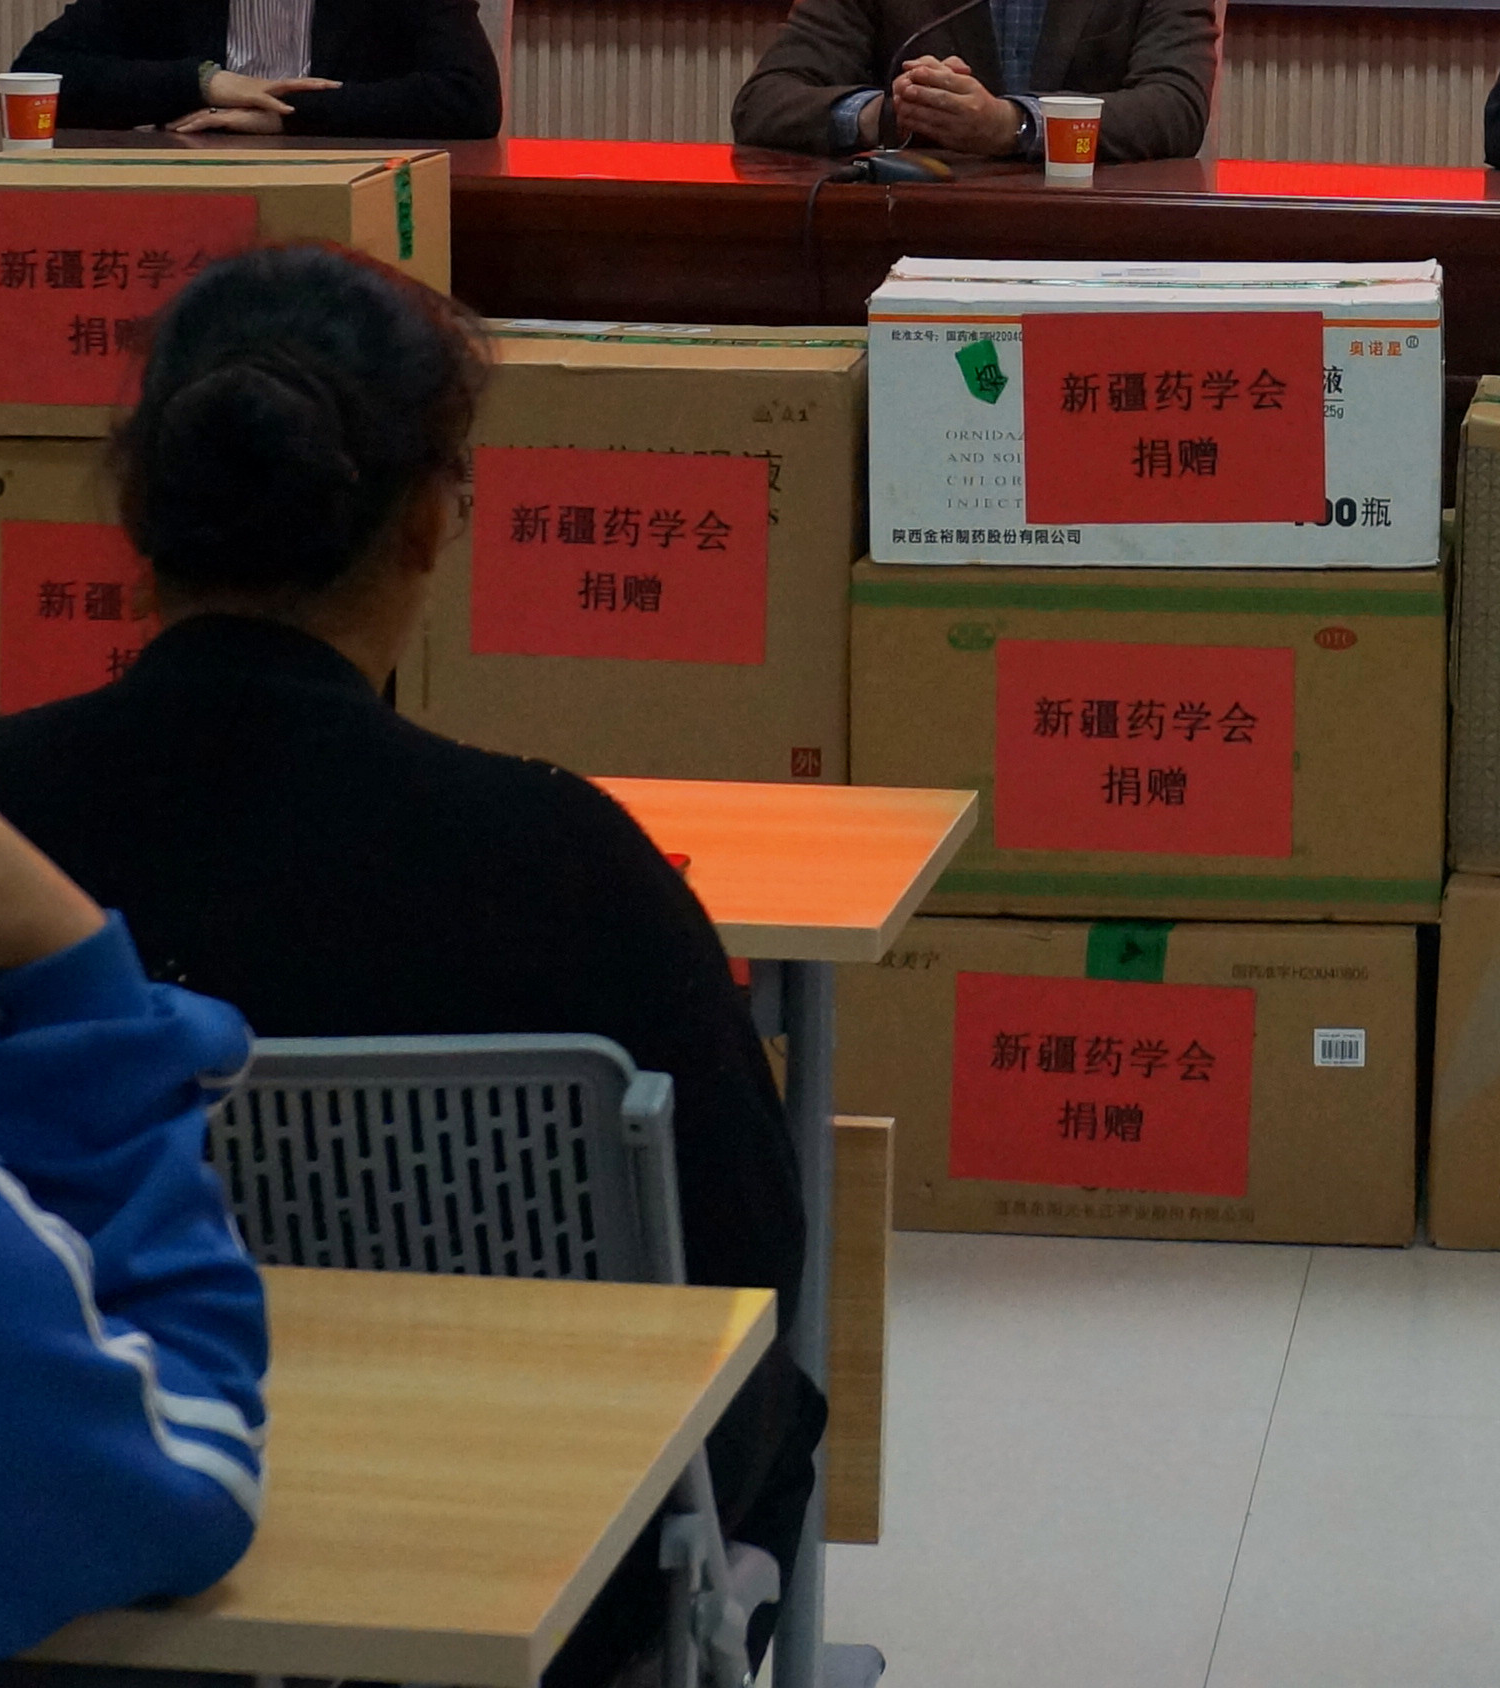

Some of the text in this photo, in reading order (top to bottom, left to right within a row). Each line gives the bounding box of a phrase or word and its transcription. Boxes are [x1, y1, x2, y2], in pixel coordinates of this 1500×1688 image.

[1350, 340, 1403, 357] 奥诺星
[1060, 367, 1288, 414] 新疆药学会
[948, 453, 985, 463] AND
[1131, 436, 1219, 479] 捐赠
[510, 503, 733, 552] 新疆药学会
[577, 569, 663, 613] 捐赠
[1033, 696, 1259, 745] 新疆药学会
[1101, 765, 1188, 808] 捐赠
[990, 1030, 1217, 1083] 新疆药学会
[1058, 1101, 1145, 1143] 捐赠
